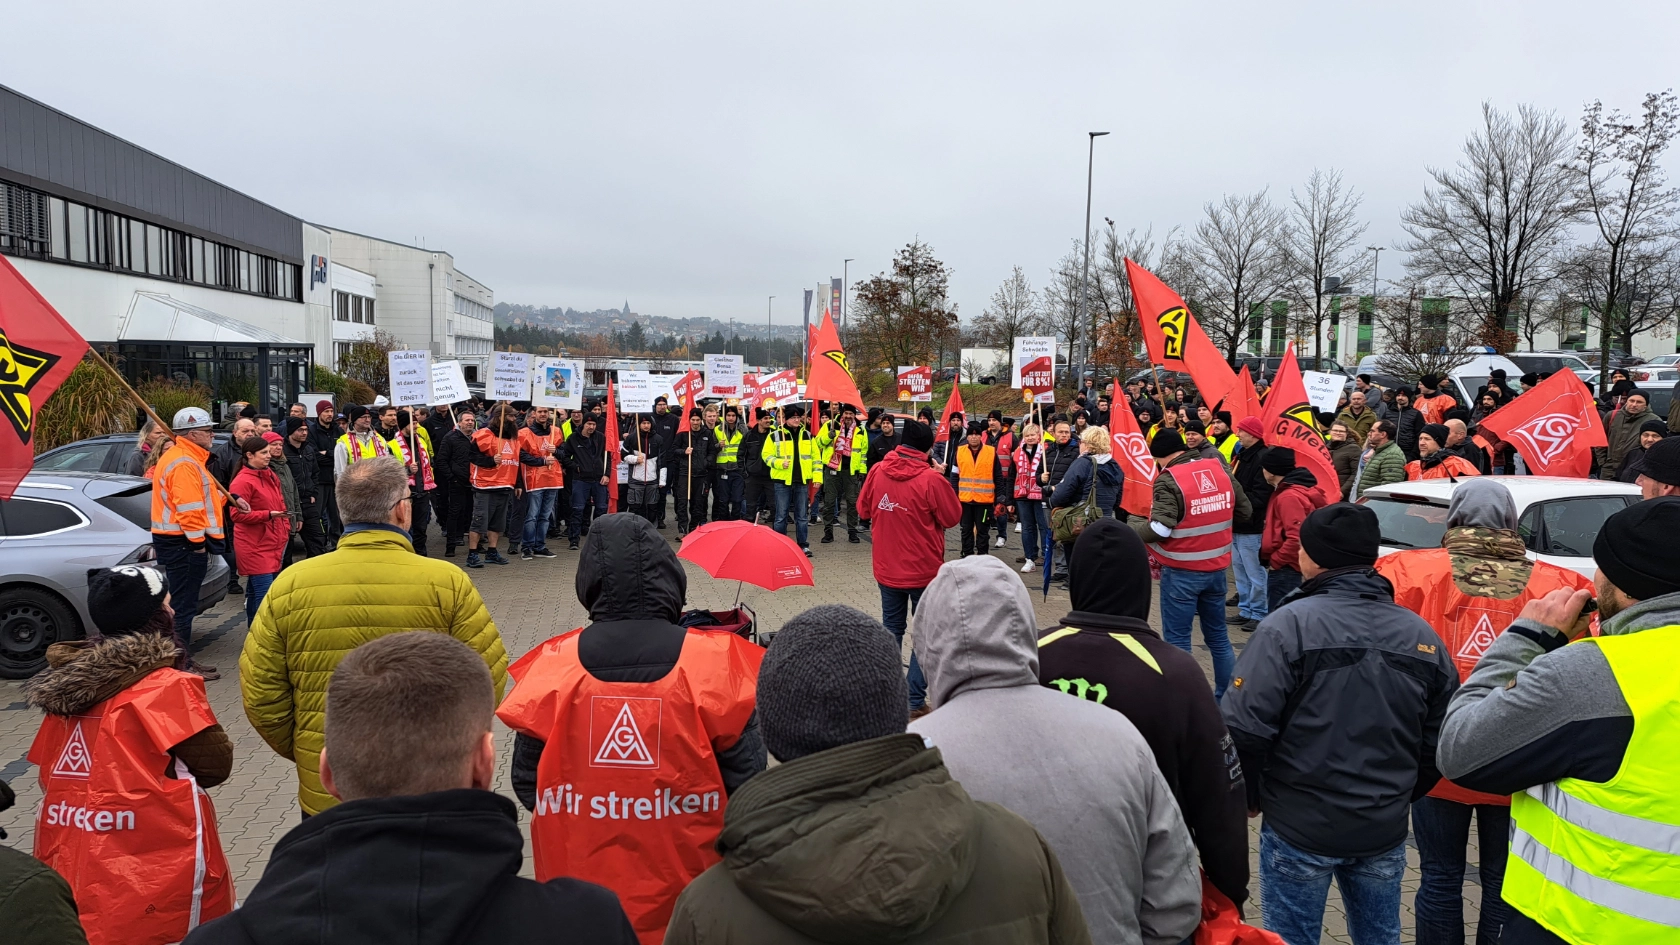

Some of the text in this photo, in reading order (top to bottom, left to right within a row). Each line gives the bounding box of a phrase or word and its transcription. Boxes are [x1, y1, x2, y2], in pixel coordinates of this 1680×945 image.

[1022, 375, 1034, 386] FÜR
[761, 381, 796, 395] STREITEN
[775, 388, 791, 397] WIR
[1272, 420, 1334, 465] IG Meta
[1190, 493, 1225, 507] SOLIDARITÄT
[535, 783, 719, 820] Wir streiken
